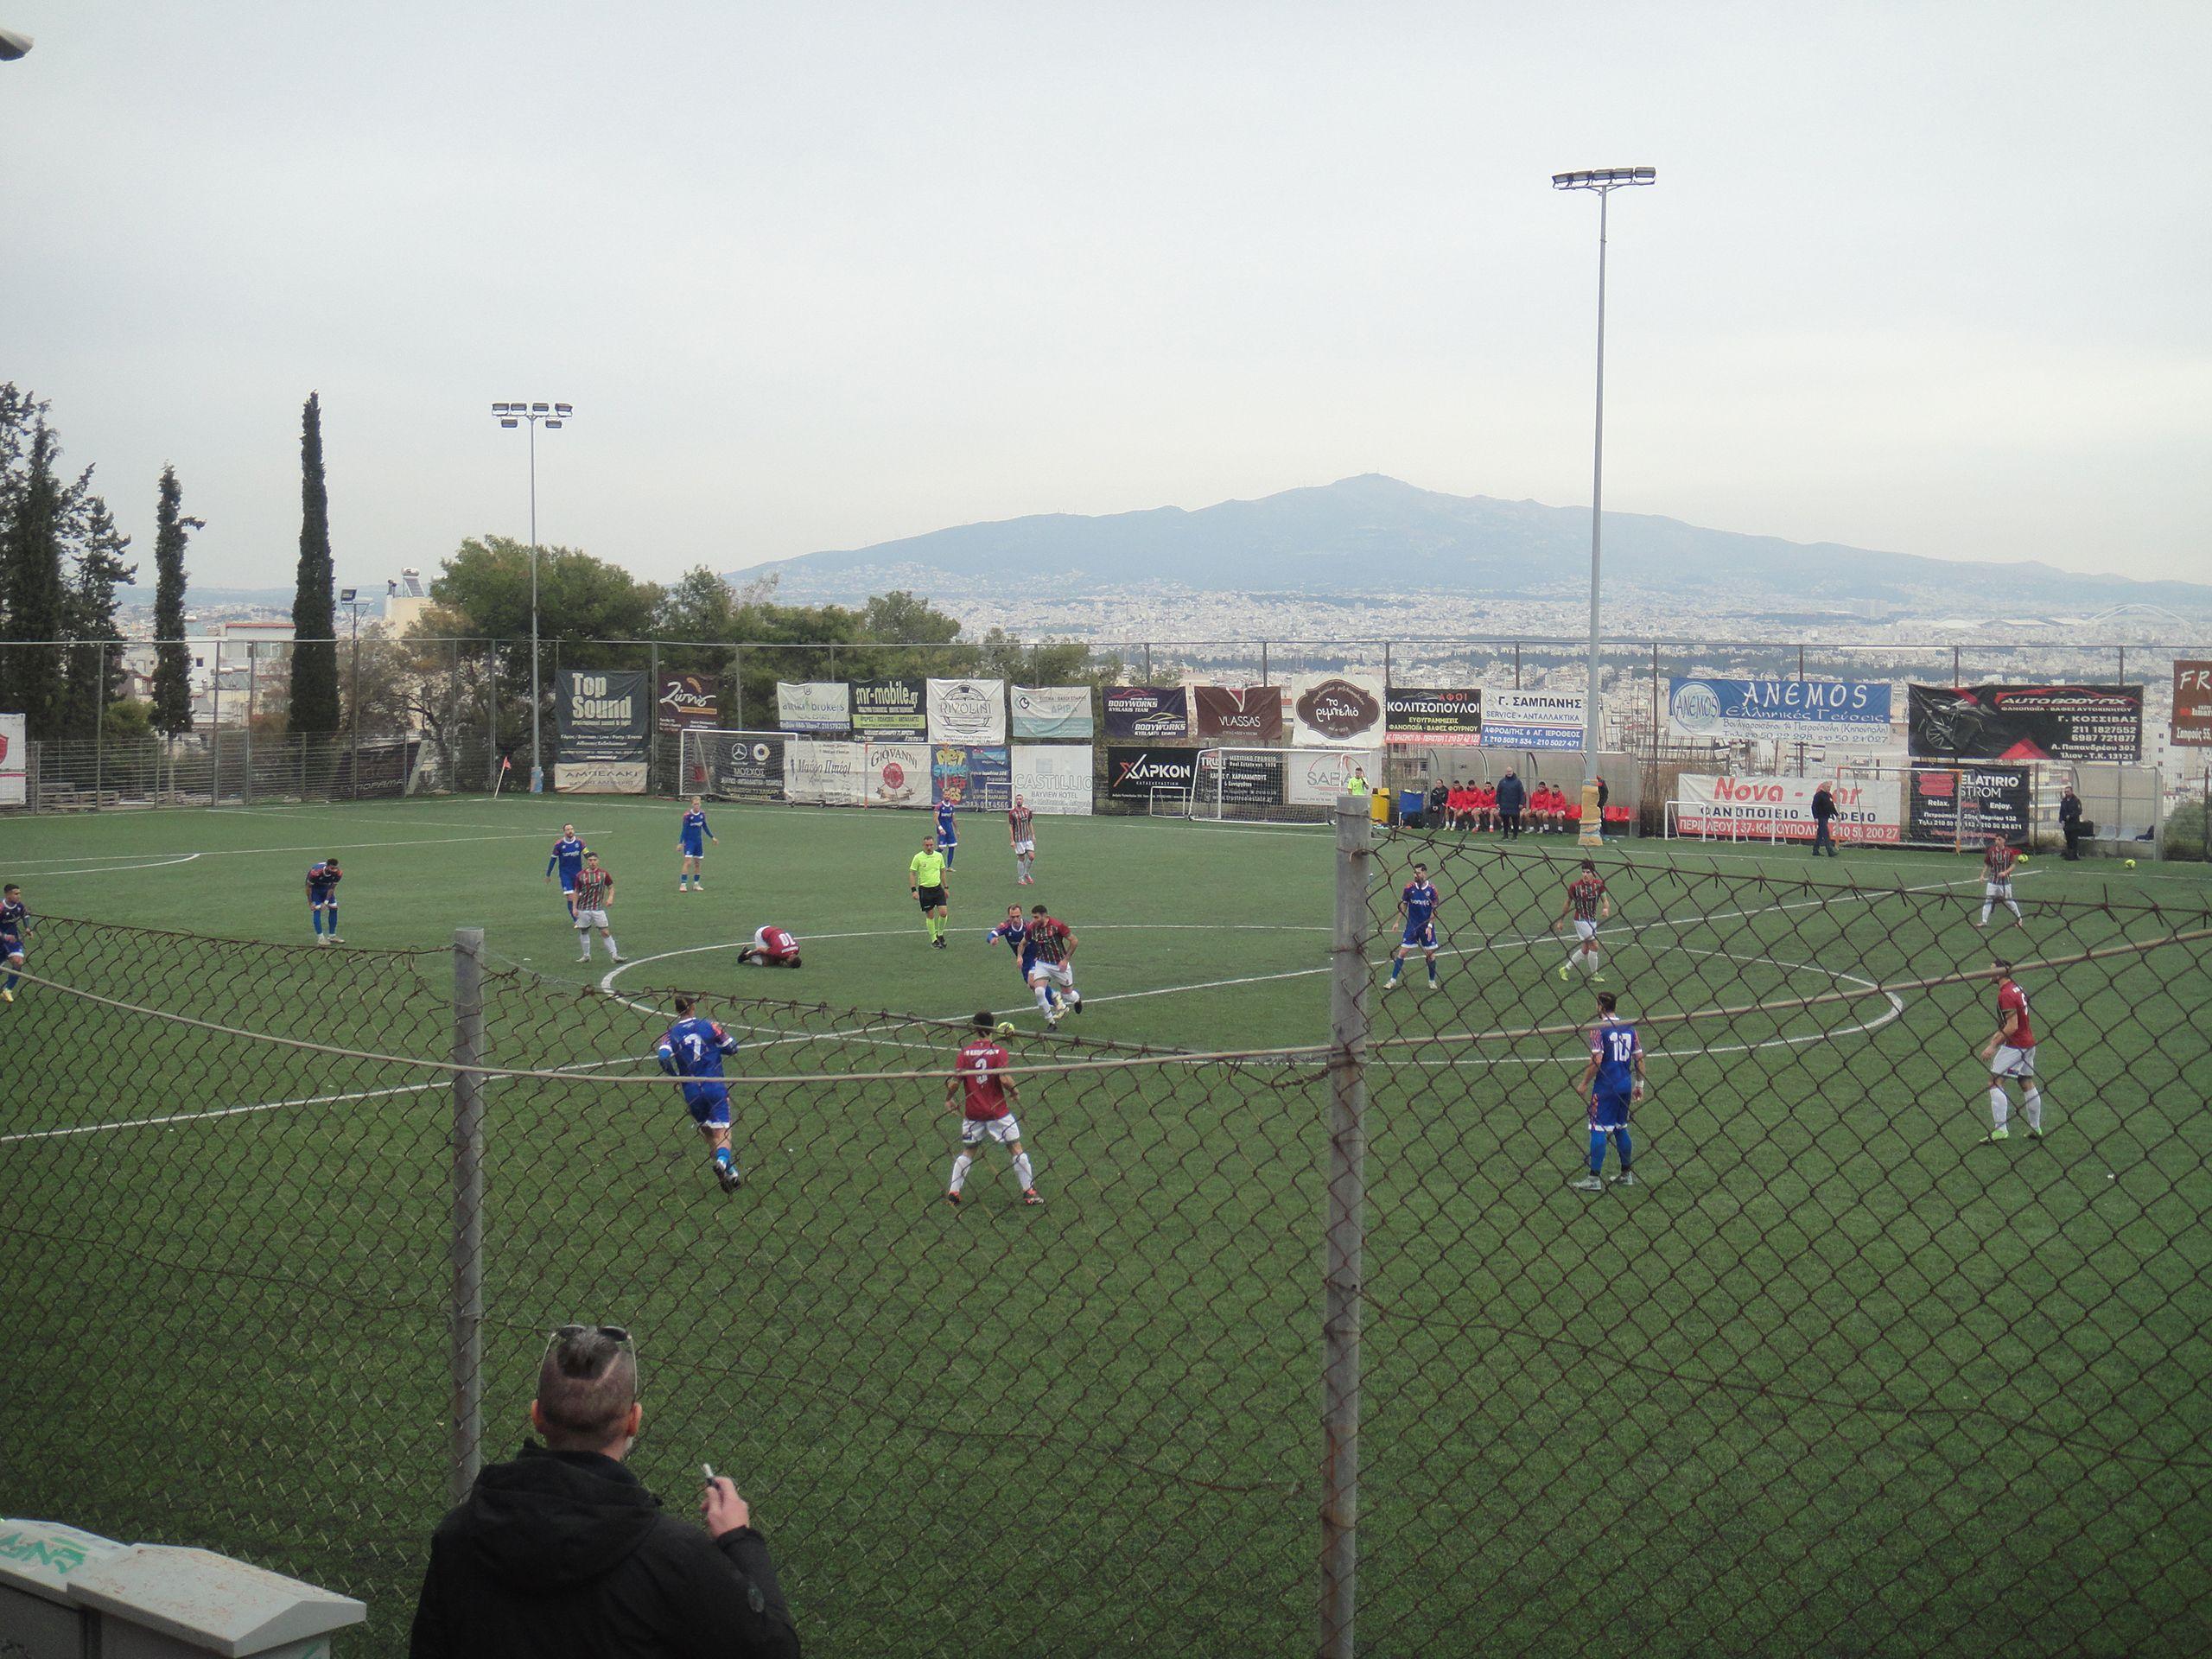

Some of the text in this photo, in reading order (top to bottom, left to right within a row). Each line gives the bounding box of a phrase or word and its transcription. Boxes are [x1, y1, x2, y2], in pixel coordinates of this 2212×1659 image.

[572, 672, 607, 698] Top
[855, 680, 918, 709] mr-mobile.gr
[1439, 693, 1467, 702] ΑΦΟΙ
[1742, 682, 1867, 709] ANEMOS
[571, 696, 632, 719] Sound
[811, 701, 845, 711] brokers
[940, 702, 992, 715] RIVOLINI
[1387, 702, 1479, 714] ΚΟΛΙΤΣΟΠΟΥΛΟΙ
[1498, 696, 1582, 709] Γ. ΣΑΜΠΑΝΗΣ
[1675, 695, 1718, 719] ANEMOS
[1315, 703, 1359, 722] ρεμπελιό
[1486, 710, 1580, 721] SERVICE ΑΝΤΑΛΛΑΚΤΙΚΑ
[1218, 715, 1261, 728] VLASSAS
[2062, 743, 2116, 752] Παπανδρέου
[870, 748, 918, 769] GIOVANNI
[733, 767, 765, 776] ΜΟΣΧΟΣ
[1713, 775, 1783, 803] Nova
[1989, 802, 2012, 810] Enjoy.
[1866, 828, 1884, 839] 200
[1886, 830, 1897, 840] 27
[1609, 1032, 1632, 1062] 10
